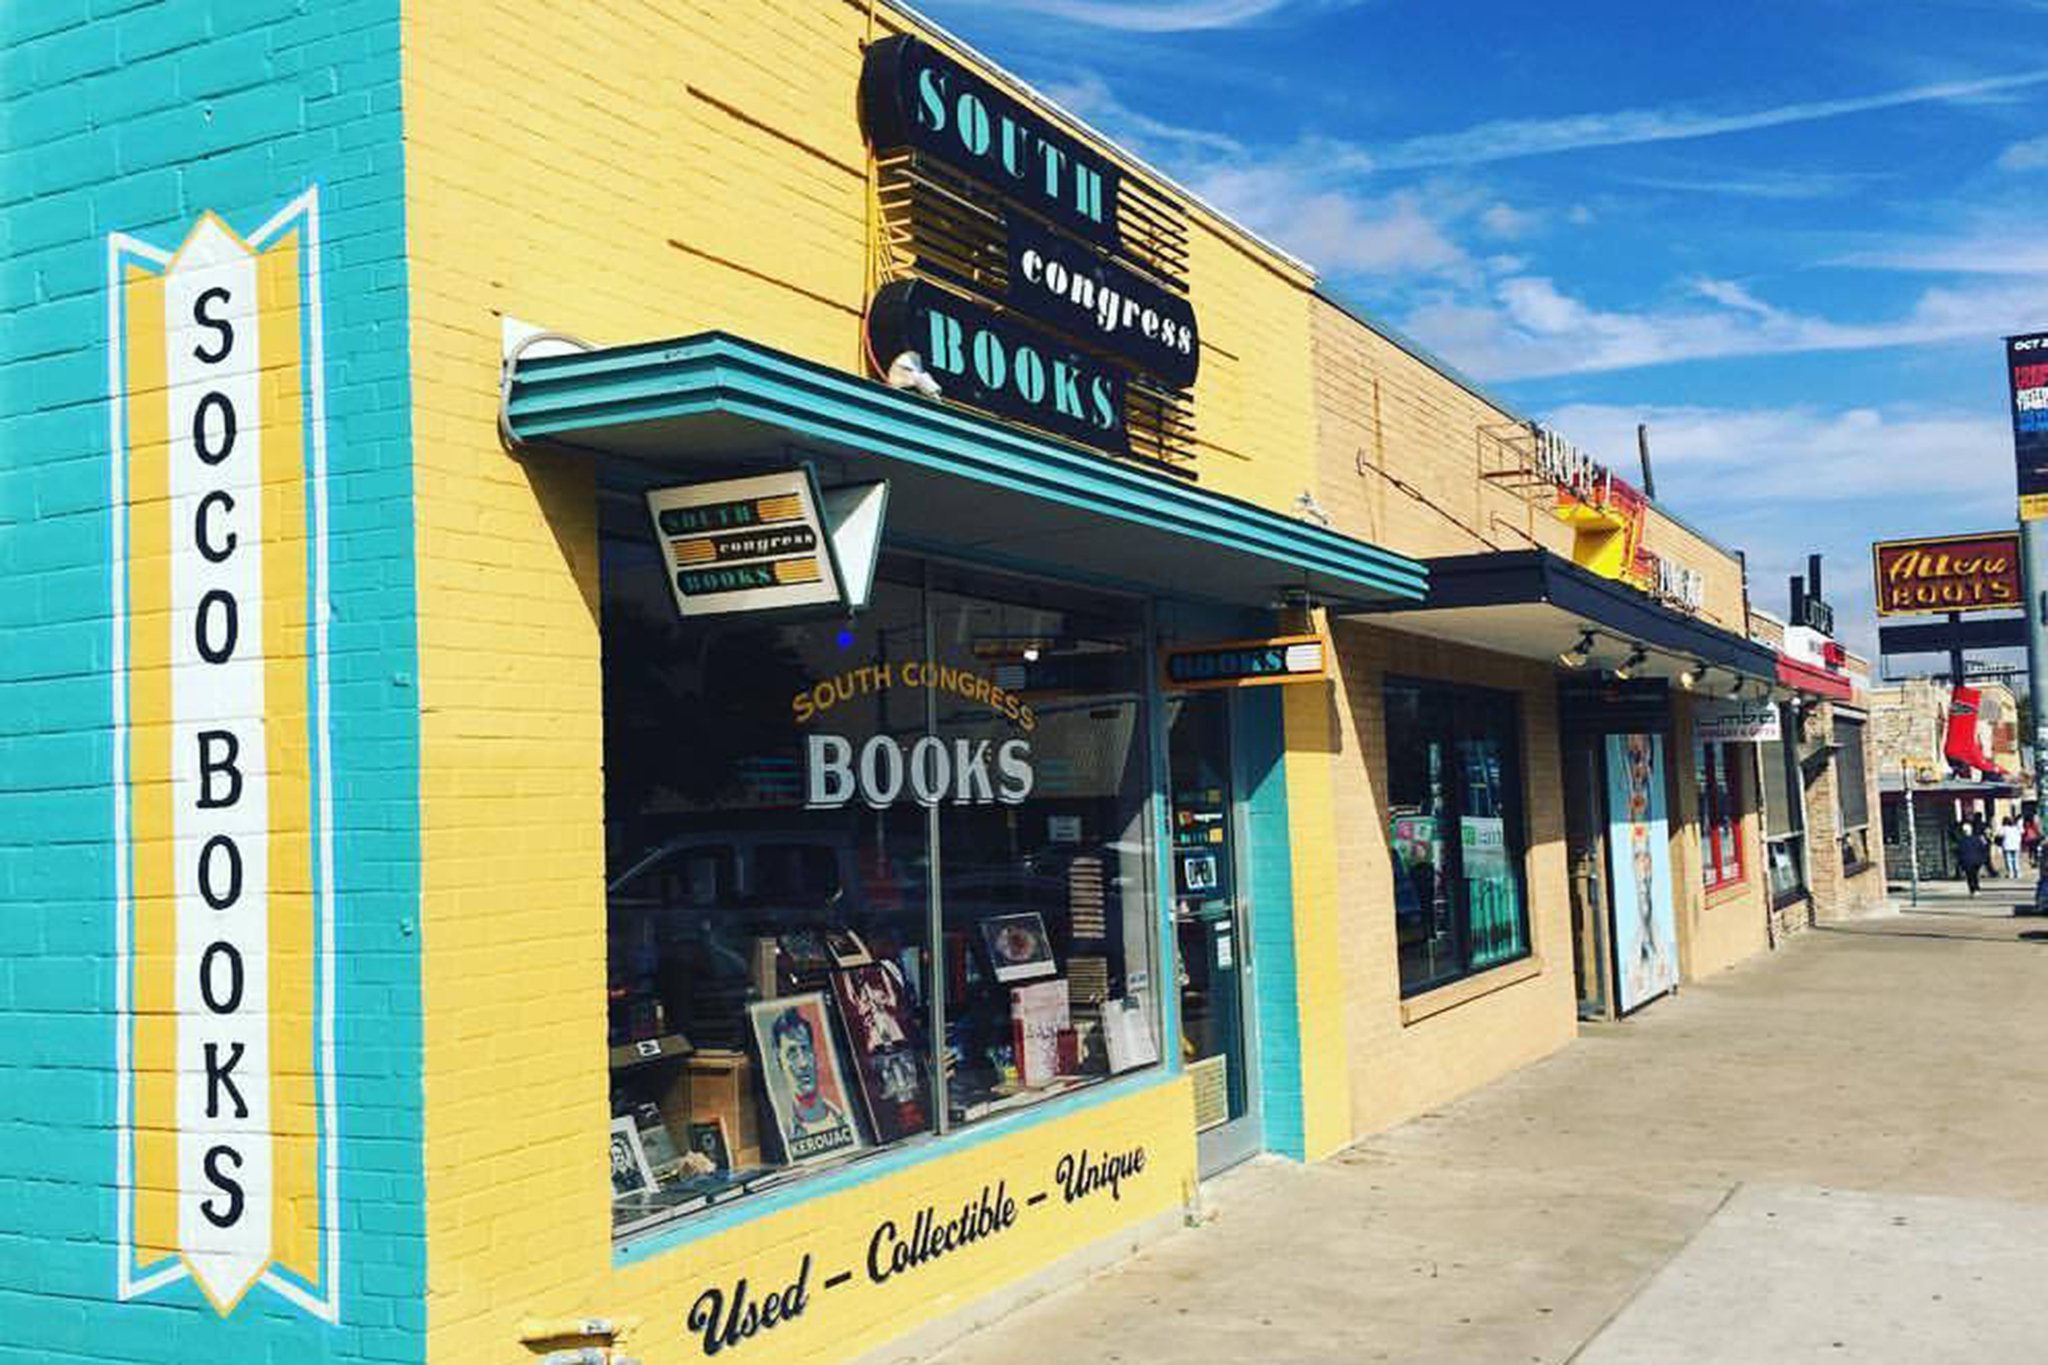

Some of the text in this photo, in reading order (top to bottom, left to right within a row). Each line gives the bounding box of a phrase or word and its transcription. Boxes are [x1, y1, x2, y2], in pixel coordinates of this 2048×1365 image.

[917, 67, 1103, 224] SOUTH
[1021, 249, 1193, 356] congress
[926, 308, 1118, 432] BOOKS
[792, 661, 1039, 732] SOUTH CONGRESS
[192, 285, 248, 1230] SOCO BOOKS
[804, 734, 1034, 810] BOOKS
[1187, 859, 1215, 888] OPEN
[791, 1127, 853, 1157] KEROUAC
[686, 1253, 811, 1358] Used
[866, 1180, 1018, 1286] Collectible
[1055, 1145, 1146, 1202] Unique
